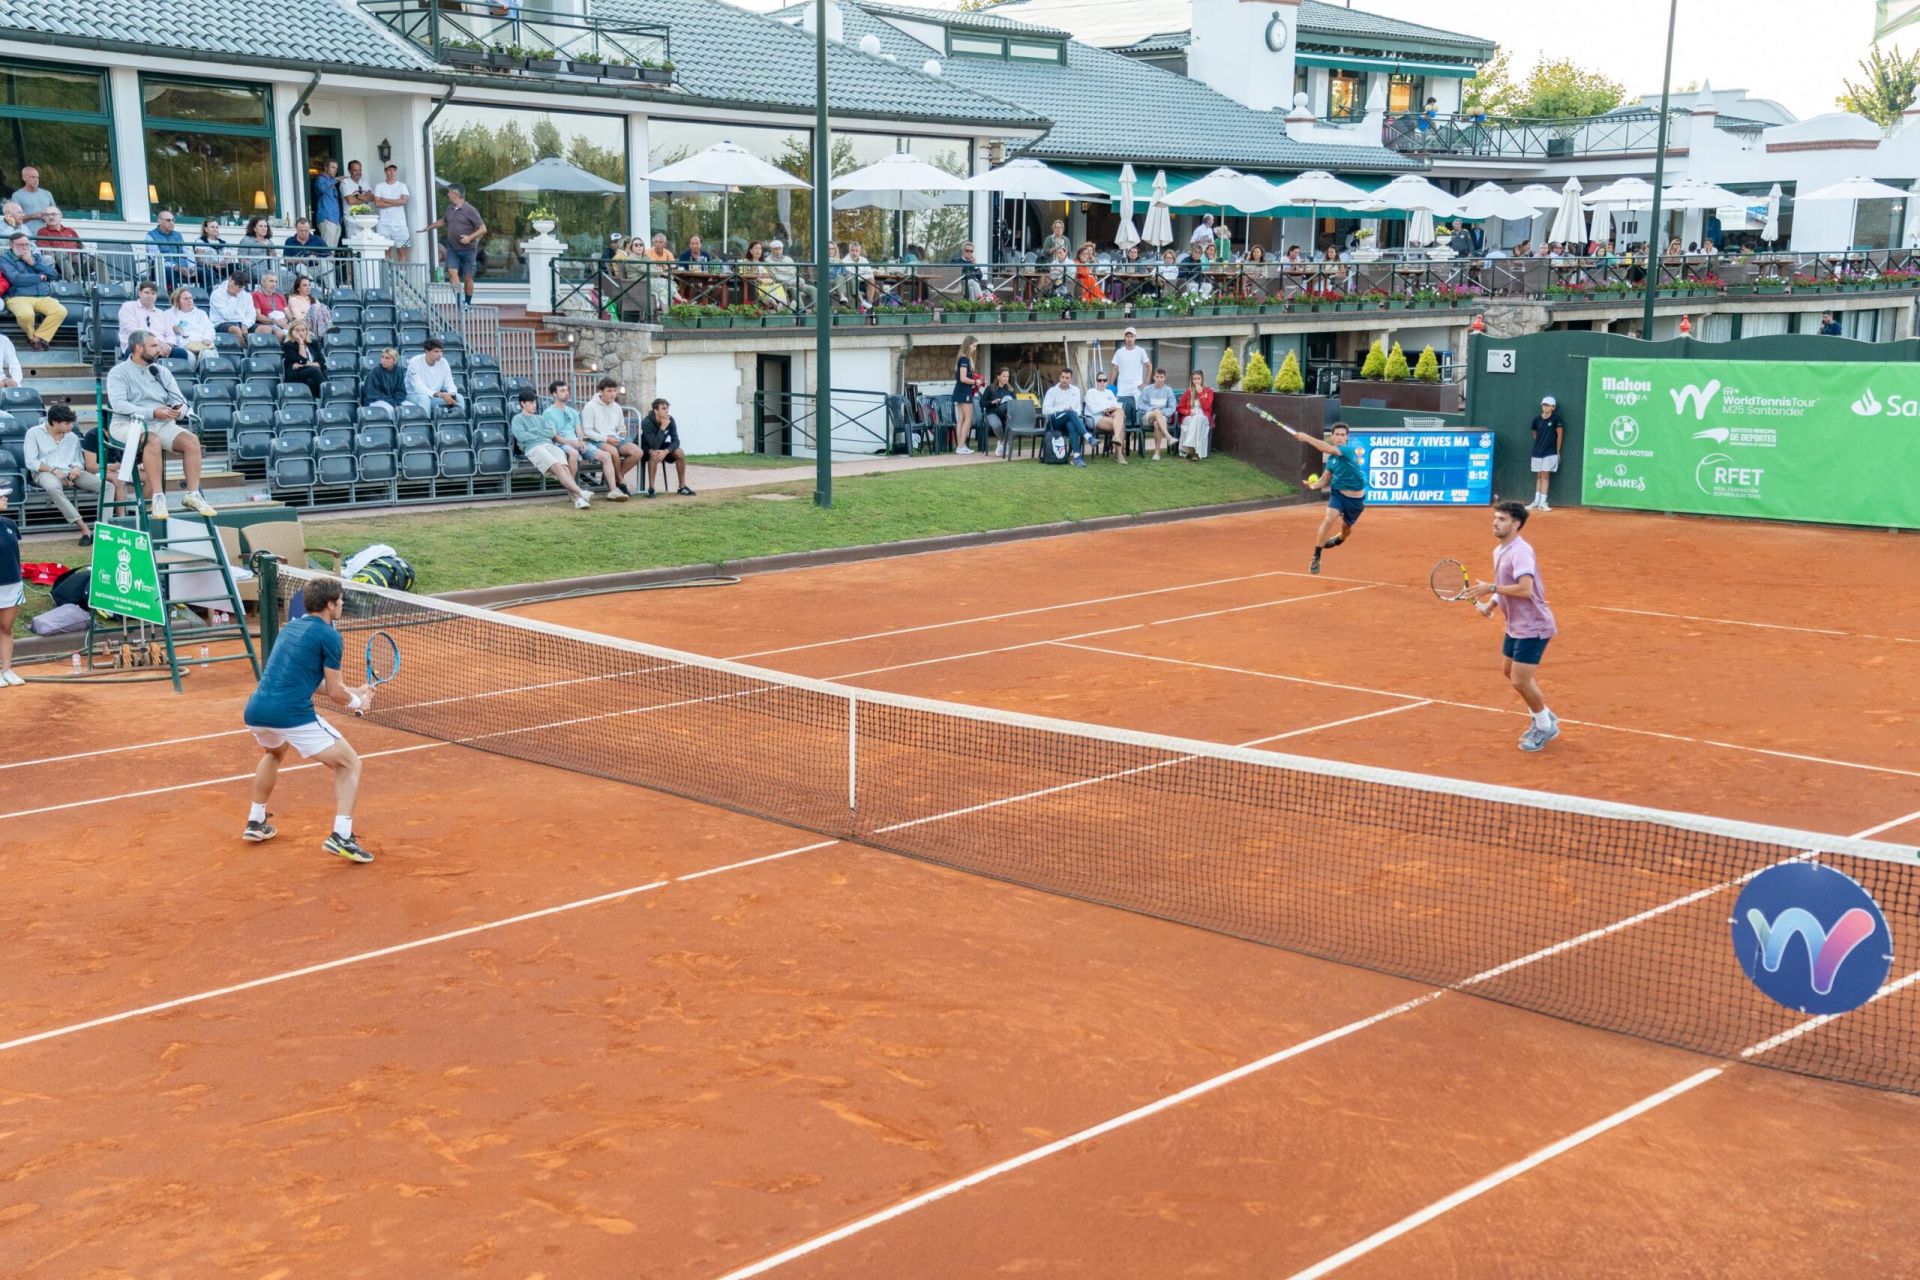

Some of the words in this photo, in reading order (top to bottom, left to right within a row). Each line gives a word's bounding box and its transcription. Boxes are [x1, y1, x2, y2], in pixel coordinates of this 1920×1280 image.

[1503, 353, 1511, 368] 3
[1602, 376, 1651, 391] Mahou
[1722, 406, 1744, 415] M25
[1747, 407, 1805, 417] Santander
[1886, 395, 1920, 416] Sa
[1369, 437, 1415, 447] SANCHEZ
[1453, 437, 1470, 447] MA
[1380, 451, 1399, 466] 30
[1410, 451, 1419, 465] 3
[1379, 471, 1399, 486] 30
[1408, 473, 1418, 487] 0
[1714, 467, 1764, 486] RFET
[1368, 490, 1388, 500] FITA
[1391, 490, 1444, 500] JUA/LOPEZ
